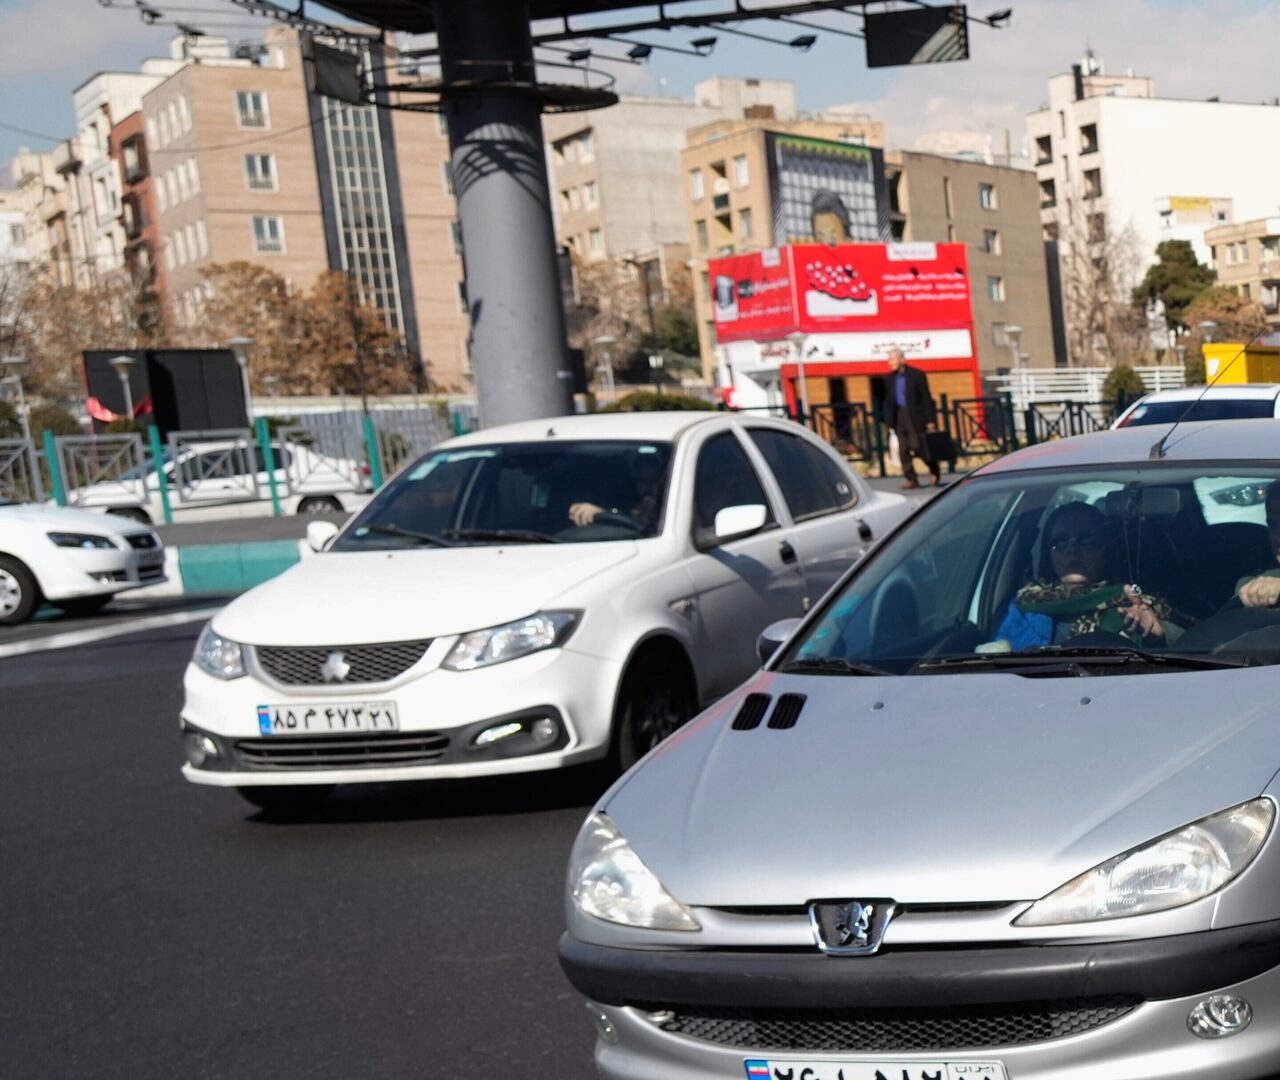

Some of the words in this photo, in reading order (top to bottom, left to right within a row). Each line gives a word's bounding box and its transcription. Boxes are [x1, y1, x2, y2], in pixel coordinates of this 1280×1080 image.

[274, 708, 298, 729] ۸۵
[304, 708, 317, 729] م
[325, 708, 363, 729] ۴۷۳
[370, 709, 394, 727] ۲۱
